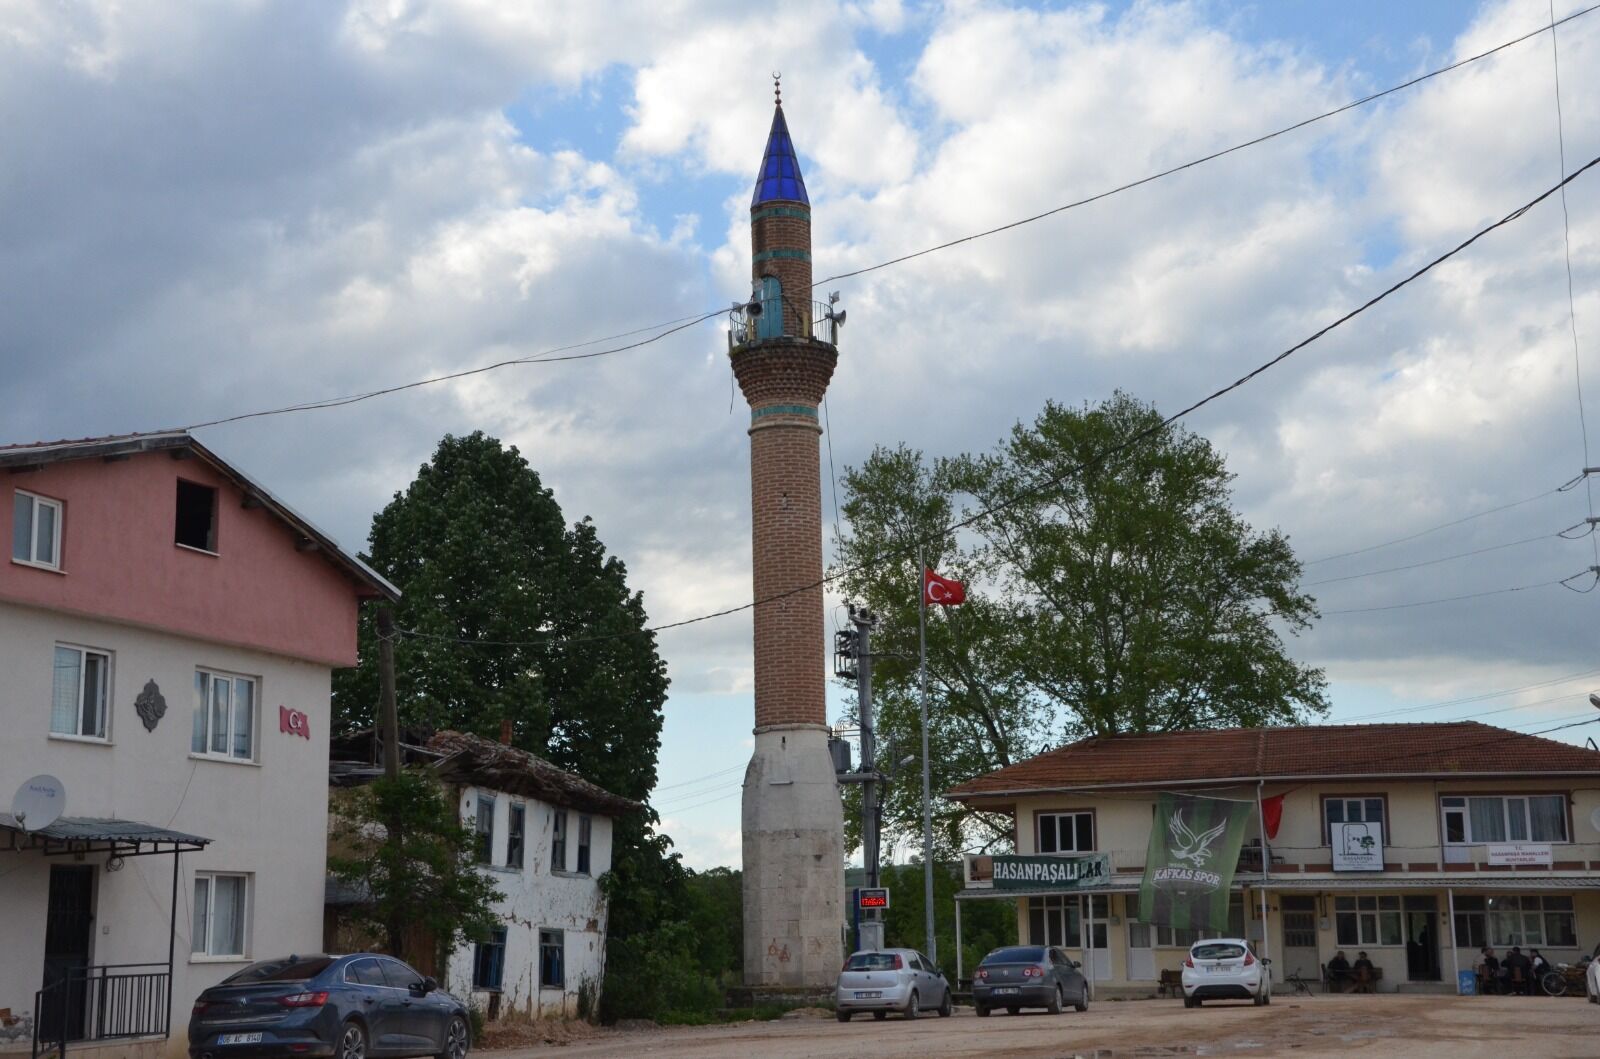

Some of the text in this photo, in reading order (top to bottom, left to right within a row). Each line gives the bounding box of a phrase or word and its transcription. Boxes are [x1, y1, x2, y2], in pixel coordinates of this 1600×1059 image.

[993, 861, 1102, 884] HASANPAŞALILAR
[1153, 868, 1220, 886] KAFKAS SPOR
